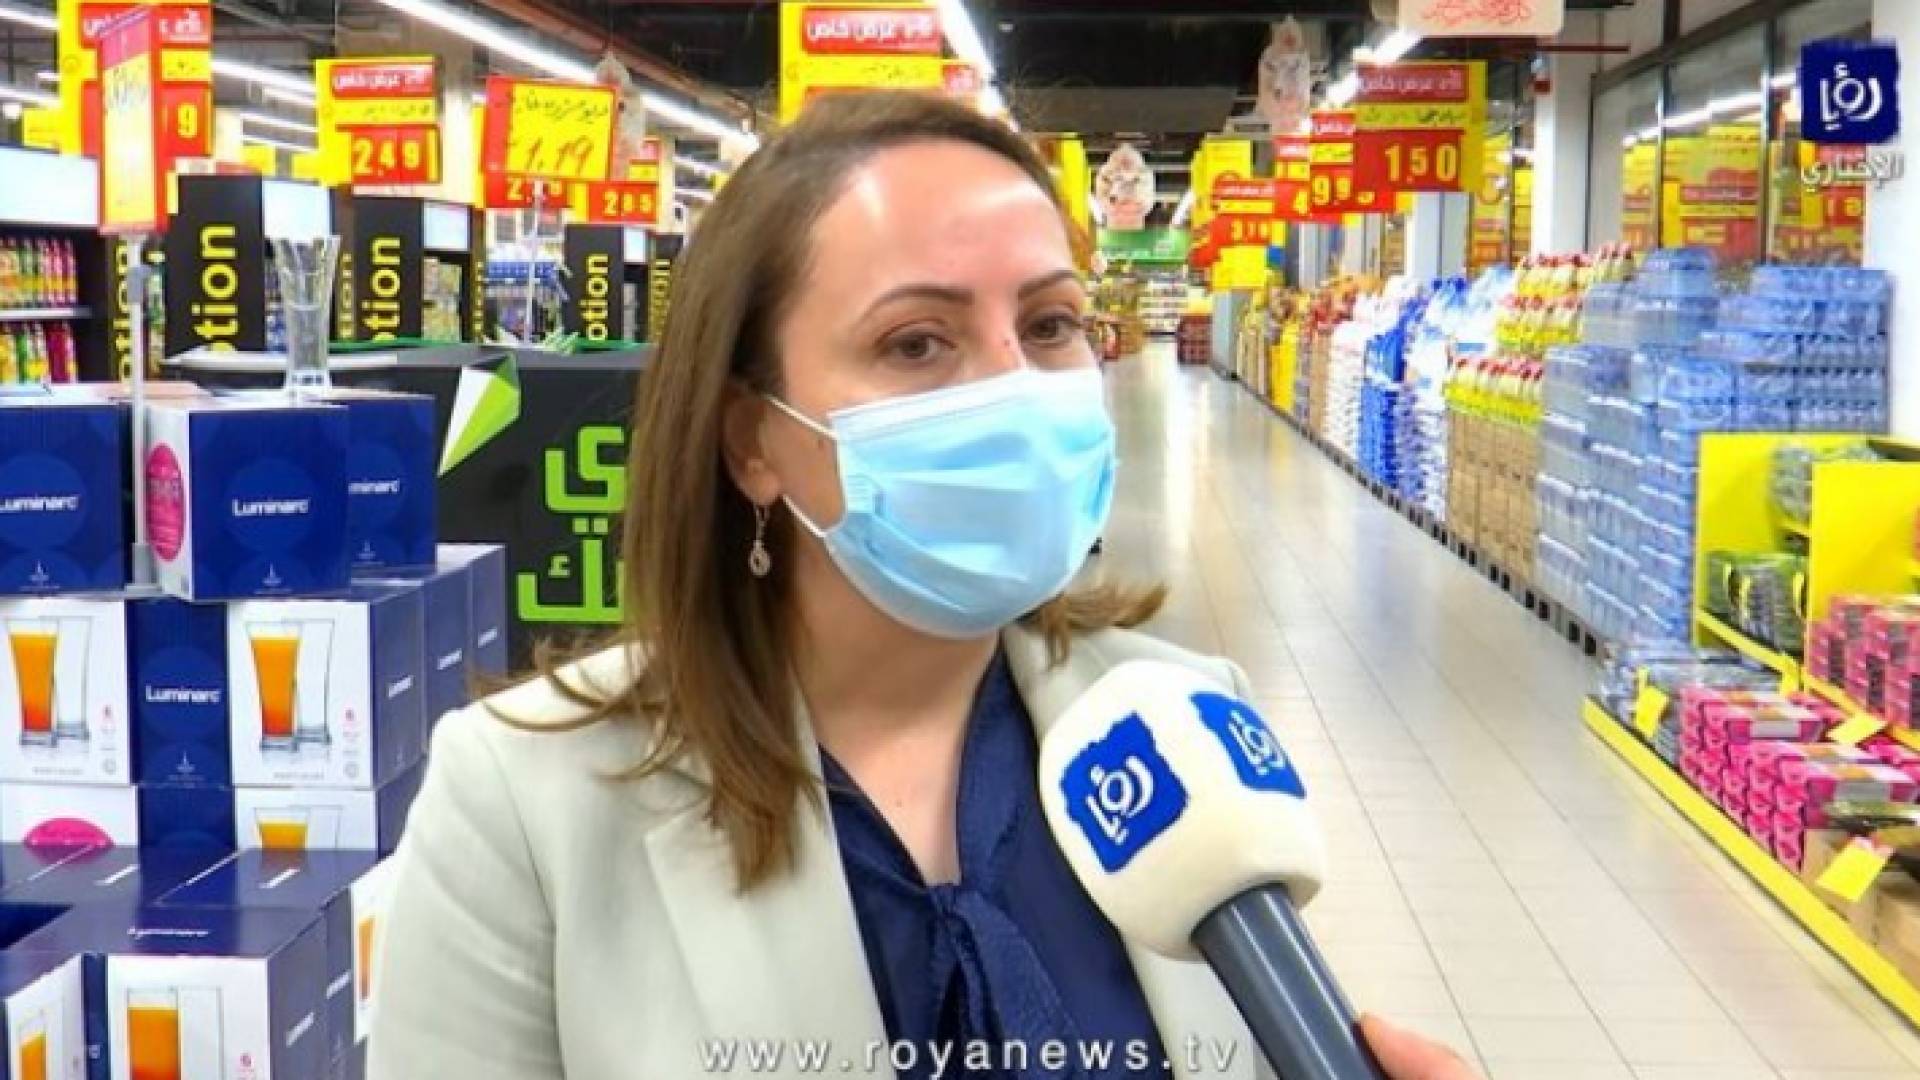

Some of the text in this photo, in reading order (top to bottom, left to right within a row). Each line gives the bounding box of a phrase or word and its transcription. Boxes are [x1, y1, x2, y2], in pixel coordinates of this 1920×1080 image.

[353, 138, 420, 176] 2.49
[1384, 144, 1458, 184] 1.50
[231, 498, 310, 517] Luminarc
[145, 684, 221, 704] Luminarc
